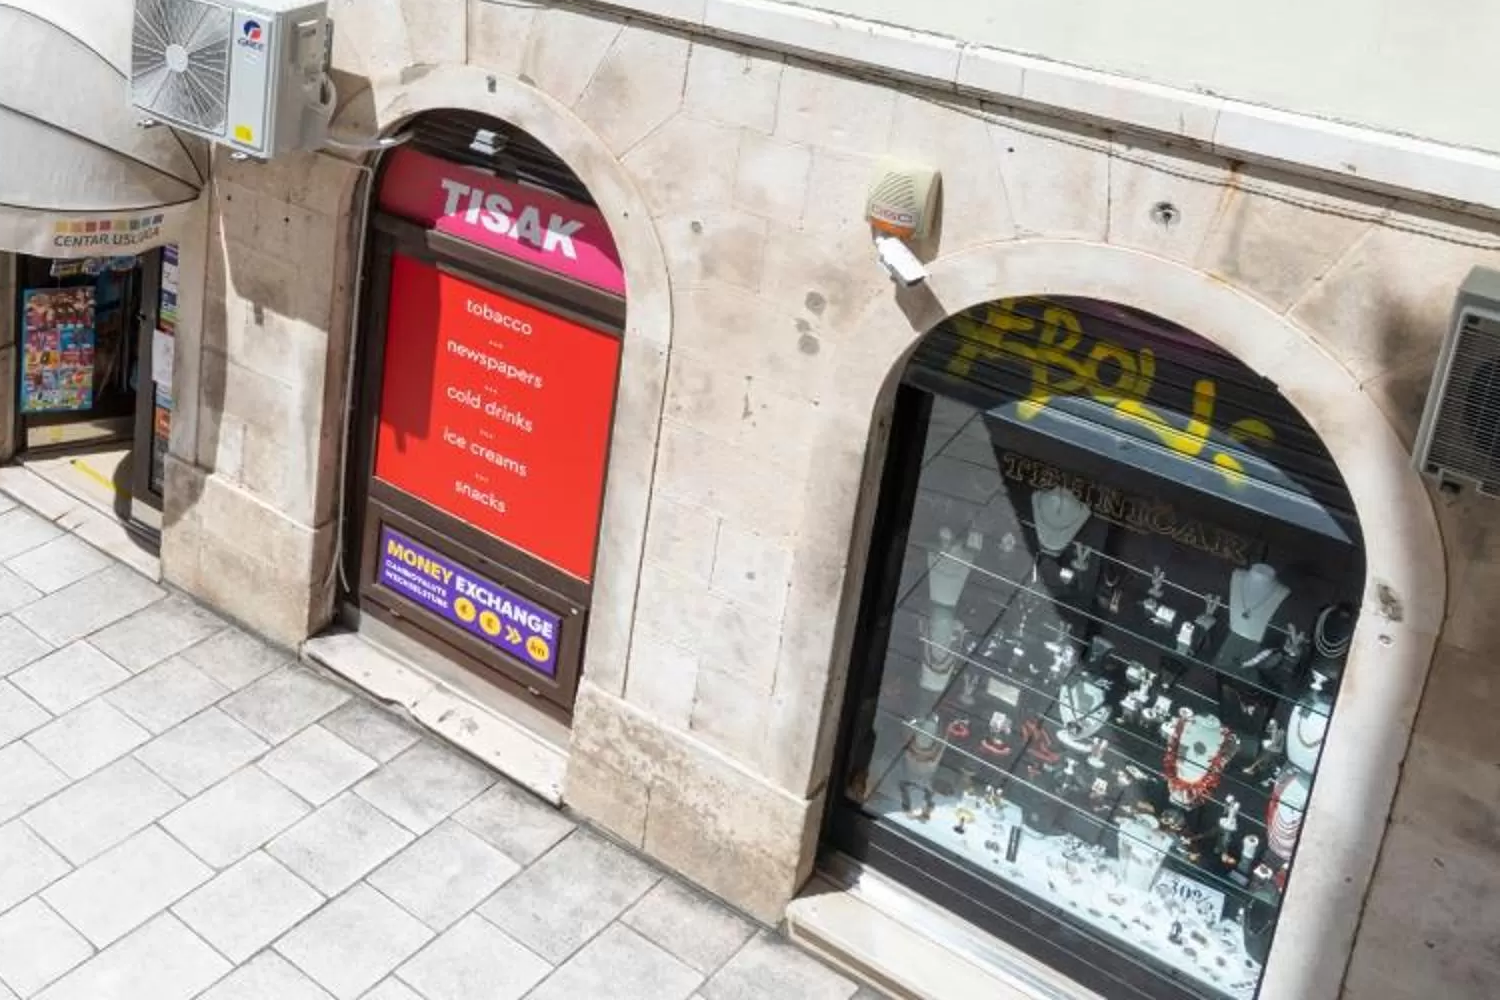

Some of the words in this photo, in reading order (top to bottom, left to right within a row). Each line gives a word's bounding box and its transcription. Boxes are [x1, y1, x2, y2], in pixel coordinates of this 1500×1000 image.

[54, 233, 110, 247] CENTAR
[441, 178, 585, 260] TISAK
[467, 299, 533, 335] tobacco
[447, 340, 543, 388] newspapers
[447, 387, 481, 409] cold
[484, 402, 533, 433] drinks
[443, 426, 467, 449] ice
[470, 443, 528, 477] creams
[455, 480, 506, 512] snacks
[387, 539, 454, 585] MONEY
[455, 575, 553, 640] EXCHANGE
